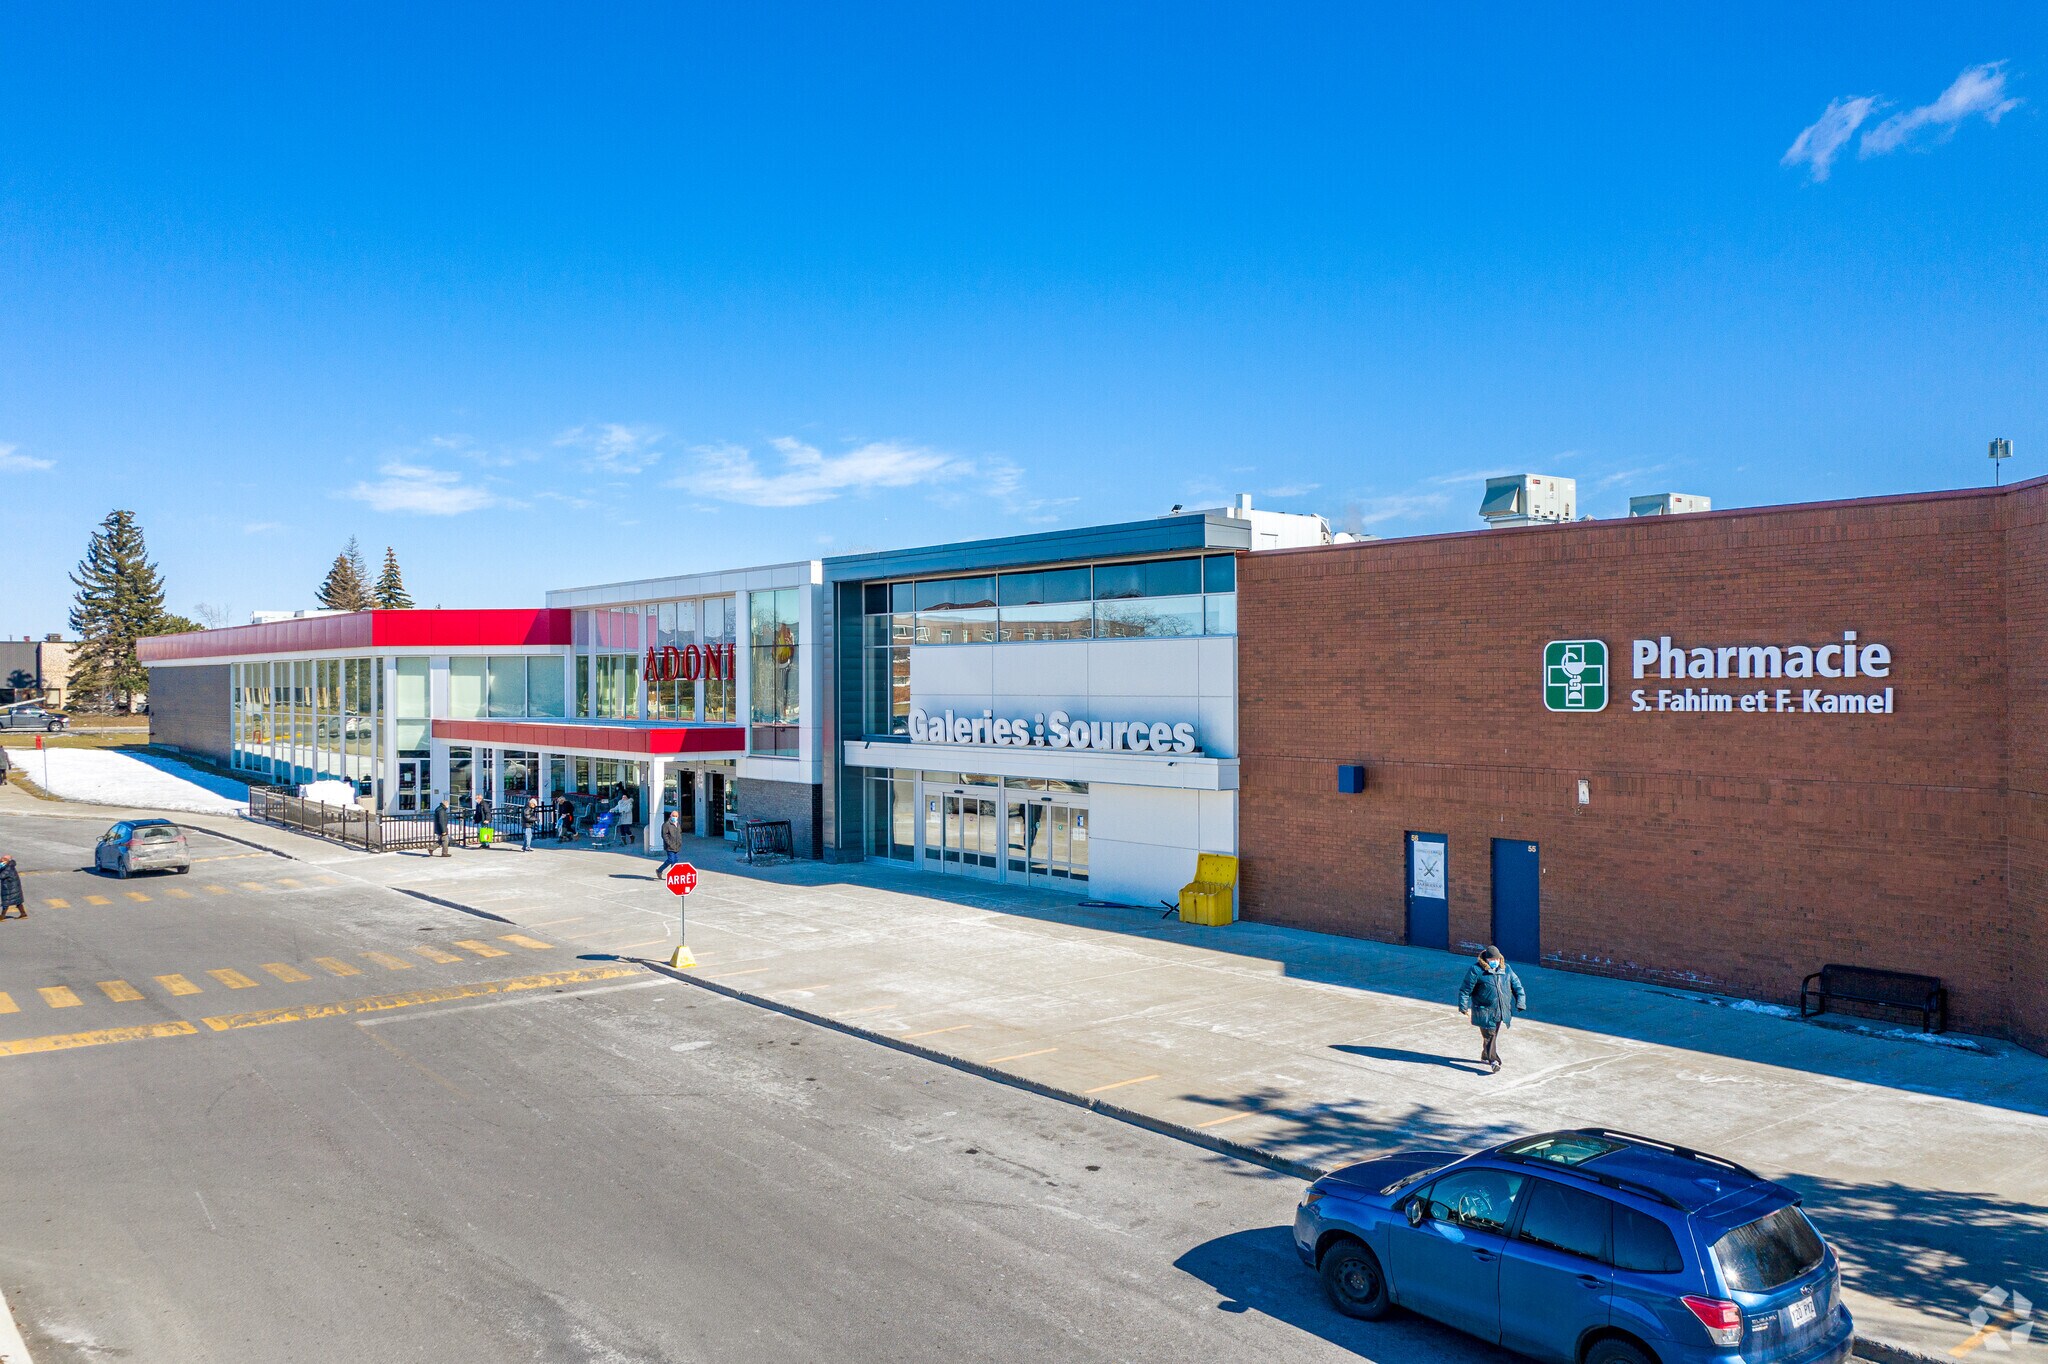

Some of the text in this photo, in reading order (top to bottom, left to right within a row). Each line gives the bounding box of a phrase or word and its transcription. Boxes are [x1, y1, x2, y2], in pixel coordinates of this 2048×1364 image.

[643, 643, 736, 682] ADONI
[1632, 630, 1892, 680] Pharmacie
[1631, 687, 1895, 714] S. Fahim et F. Kamel
[908, 707, 1031, 748] Galeries
[1048, 709, 1197, 755] Sources
[667, 872, 697, 886] ARRÊT
